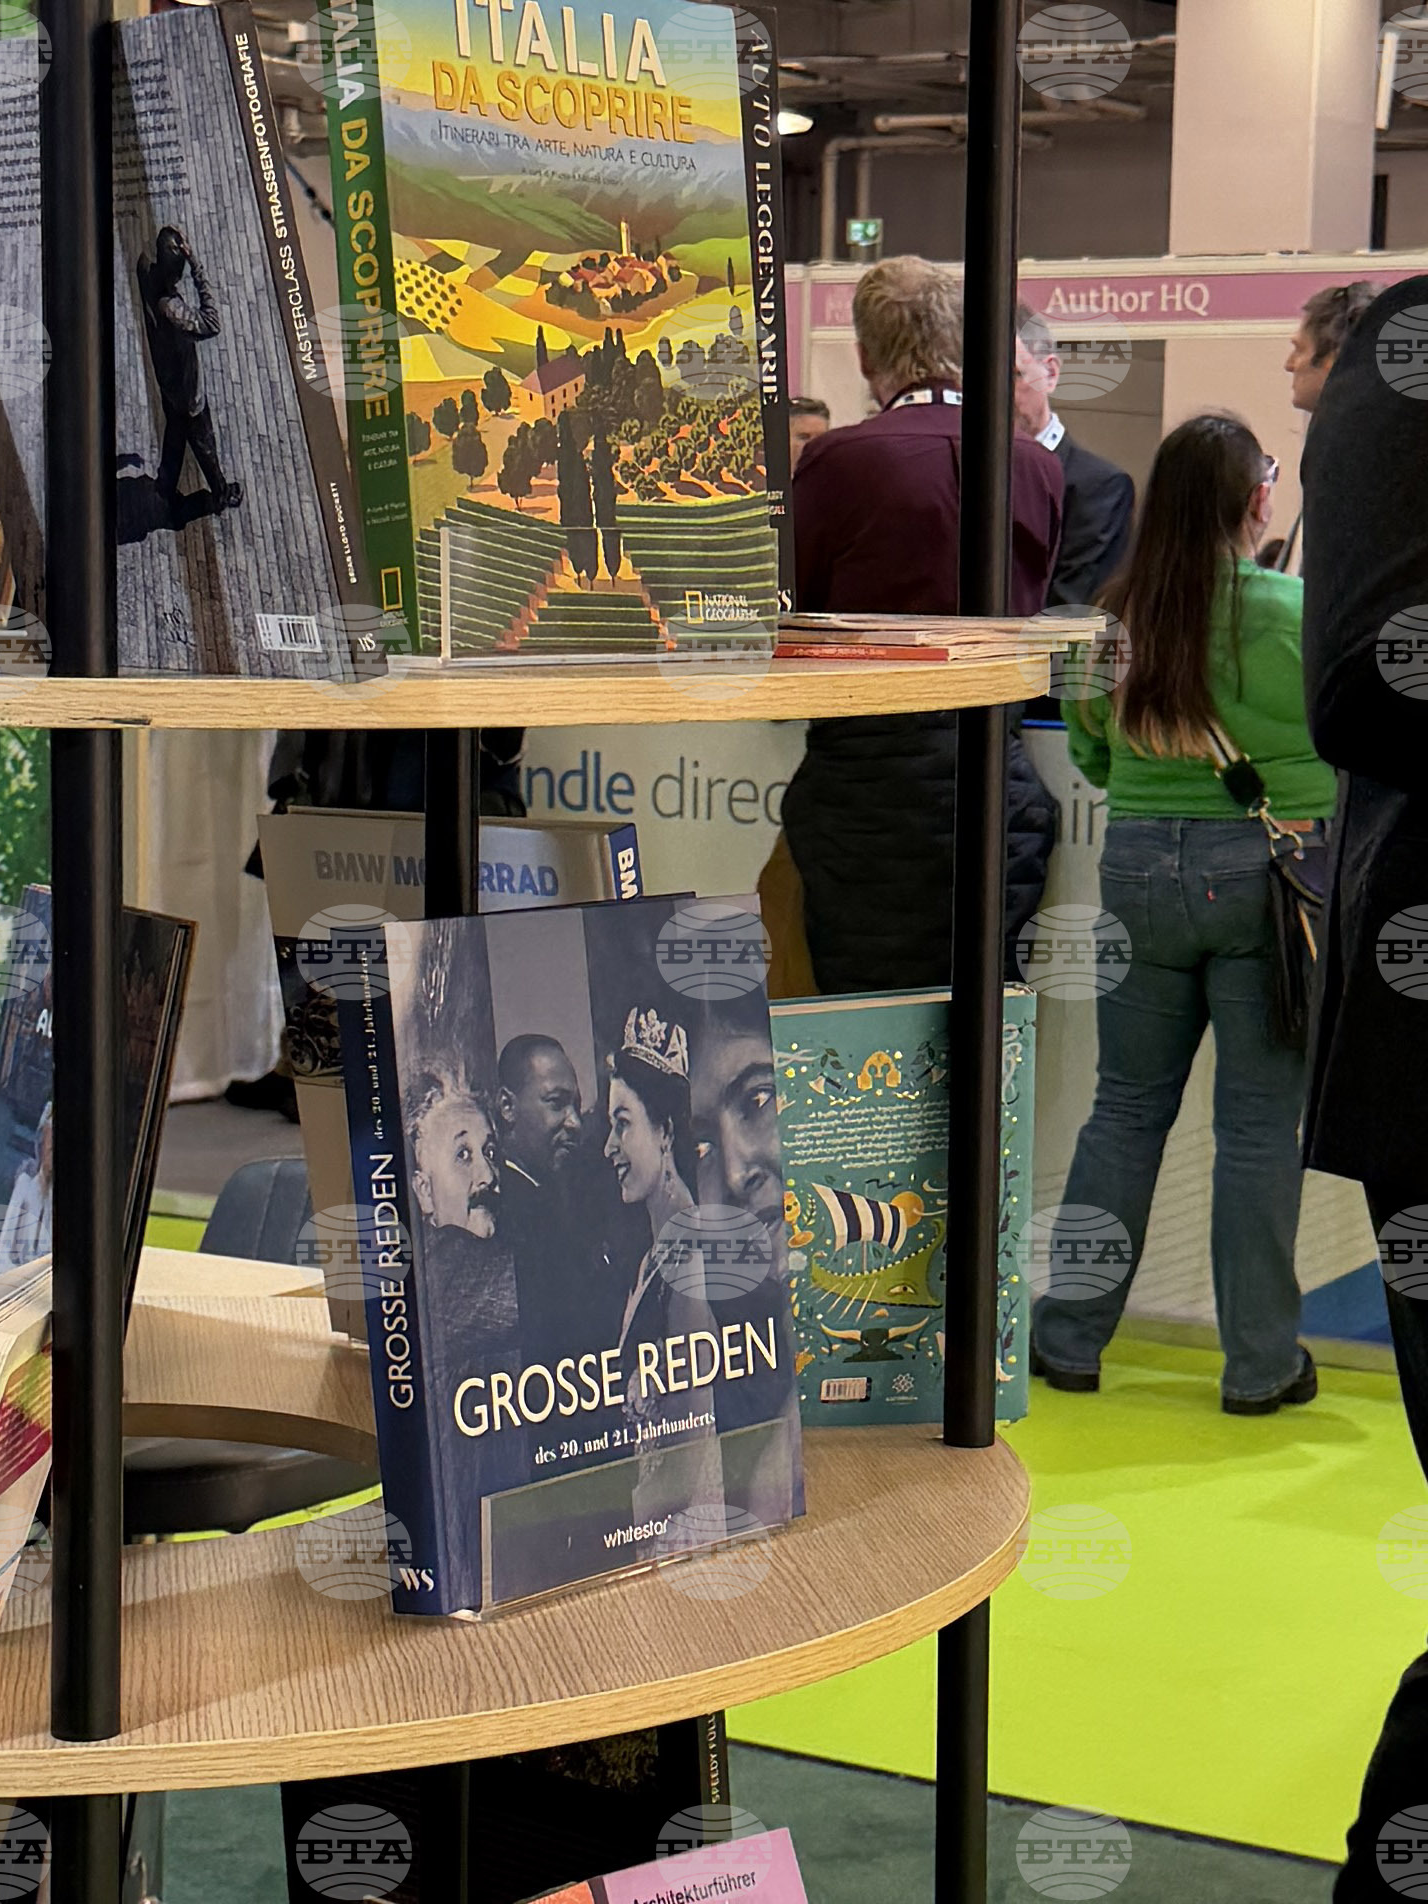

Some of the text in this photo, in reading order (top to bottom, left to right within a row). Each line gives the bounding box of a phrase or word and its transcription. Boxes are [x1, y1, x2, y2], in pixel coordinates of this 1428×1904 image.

[432, 59, 696, 145] DA SCOPRIRE
[340, 117, 370, 183] DA
[504, 133, 530, 151] TRA
[535, 138, 570, 158] ARTE,
[573, 141, 625, 163] NATURA
[630, 150, 637, 165] E
[640, 151, 697, 171] CULTURA
[235, 30, 318, 381] MASTERCLASS STRASSENFOTOGRAFIE
[749, 29, 780, 407] AUTO LEGGENDARIE
[346, 190, 392, 423] SCOPRIRE
[1045, 282, 1211, 318] Author HQ
[524, 750, 787, 827] ndle direc
[313, 850, 386, 885] BMW
[369, 1152, 414, 1409] GROSSE REDEN
[454, 1317, 778, 1437] GROSSE REDEN
[534, 1412, 716, 1465] des 20. und 21. Jahrhunderts
